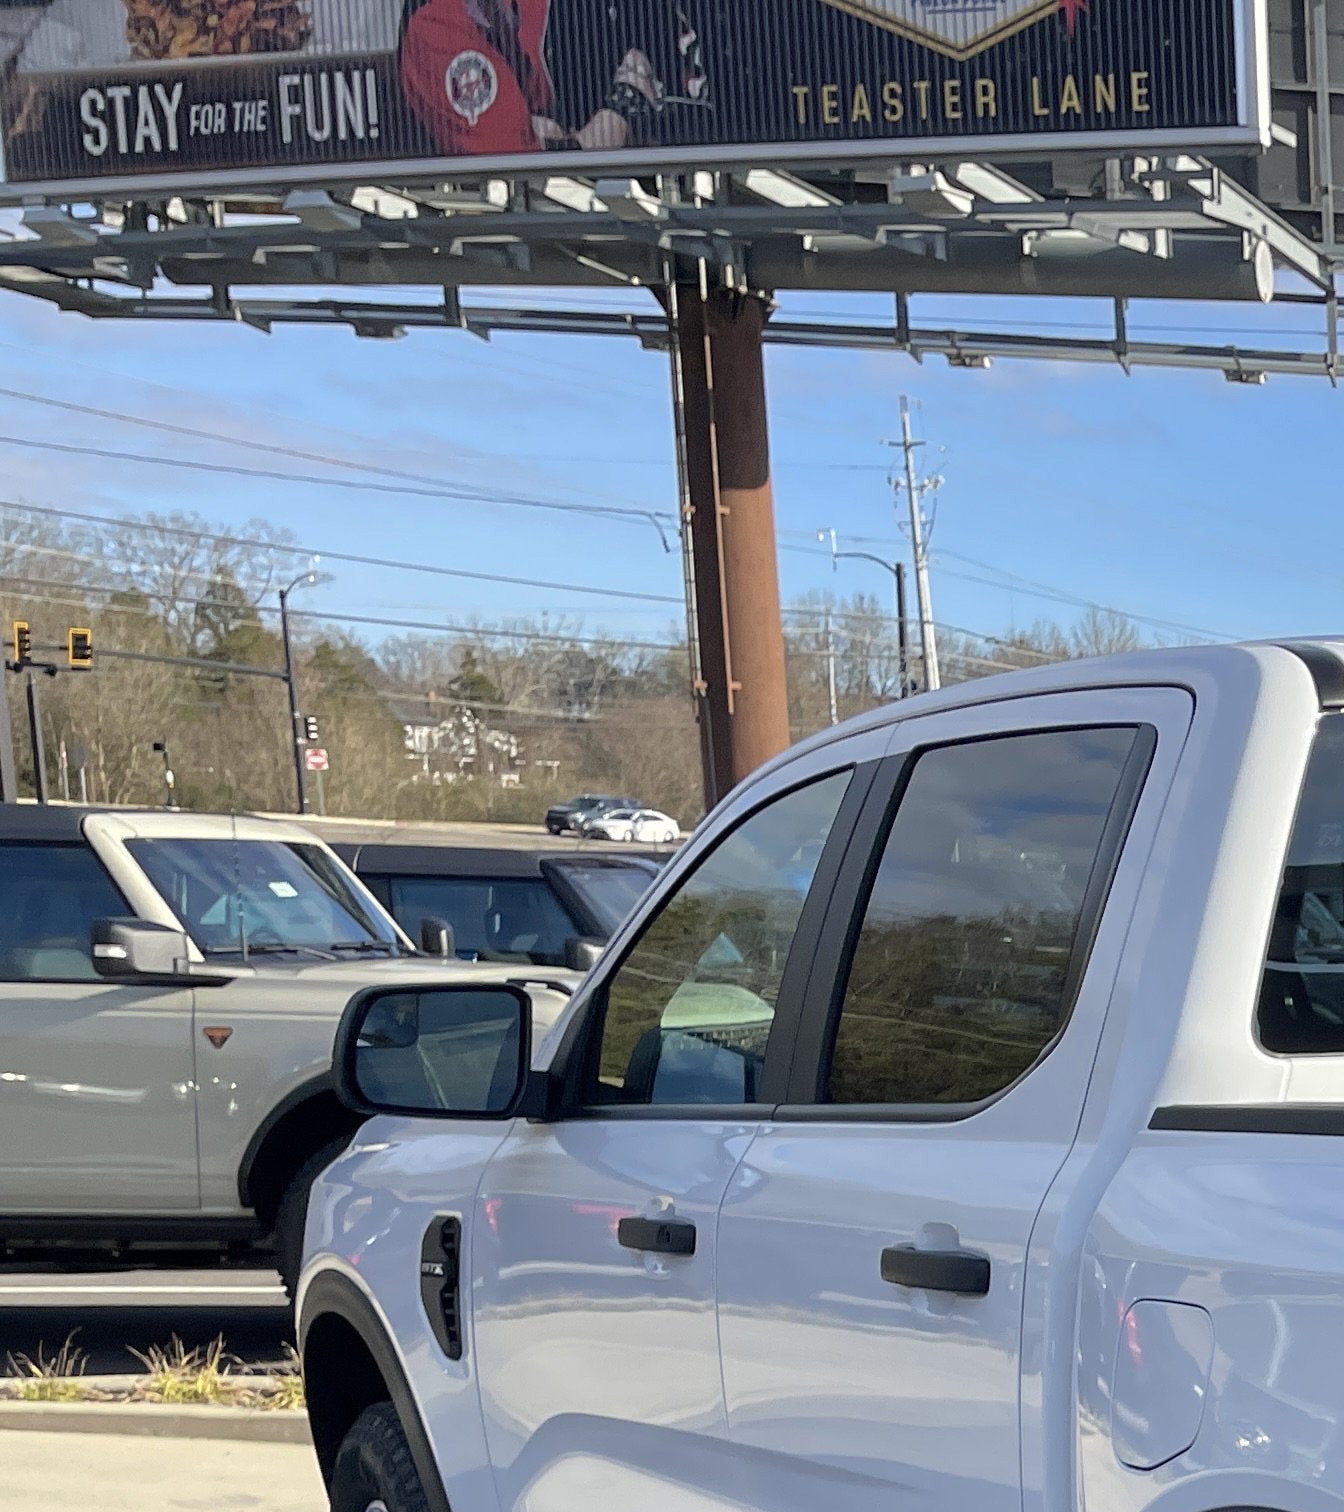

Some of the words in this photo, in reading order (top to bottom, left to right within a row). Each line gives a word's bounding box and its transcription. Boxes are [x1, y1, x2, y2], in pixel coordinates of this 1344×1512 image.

[79, 82, 184, 157] STAY
[189, 102, 227, 137] FOR
[231, 99, 269, 134] THE
[277, 67, 380, 145] FUN!
[792, 78, 997, 126] TEASTER
[1031, 71, 1151, 117] LANE
